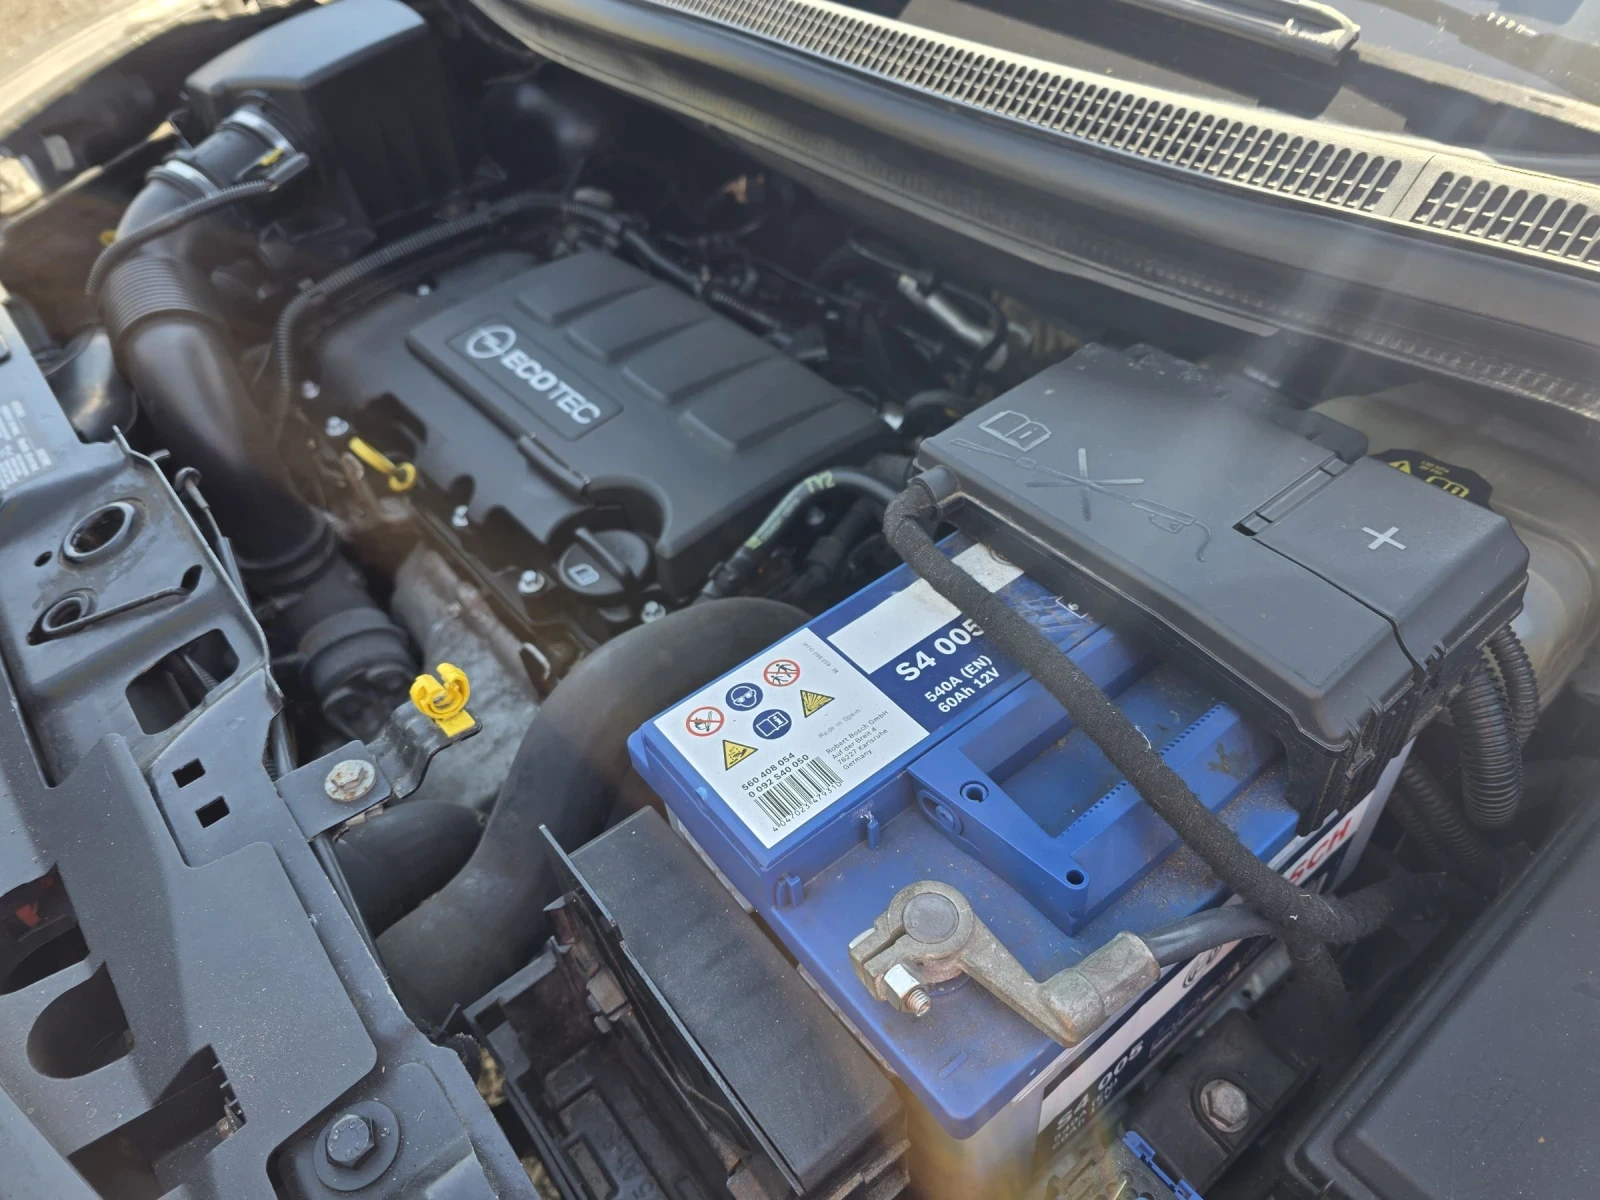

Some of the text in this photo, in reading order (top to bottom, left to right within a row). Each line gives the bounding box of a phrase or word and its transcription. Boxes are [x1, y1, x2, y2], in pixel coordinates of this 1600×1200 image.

[500, 348, 601, 424] ECOTEC
[895, 618, 985, 682] S4 005
[924, 654, 993, 703] 540A (EN)
[937, 666, 1000, 713] 60Ah 12V
[825, 709, 889, 755] Robert Bosch GmbH
[831, 749, 844, 760] Auf
[843, 741, 856, 752] der
[854, 730, 873, 744] Breit
[836, 728, 889, 765] 76227 Karlsruhe
[741, 752, 796, 791] 560 408 054
[756, 778, 774, 793] 092
[774, 766, 792, 781] S40
[791, 754, 809, 768] 050
[842, 748, 873, 771] Germany
[1289, 817, 1352, 883] SCH
[1056, 1039, 1144, 1131] S4 005
